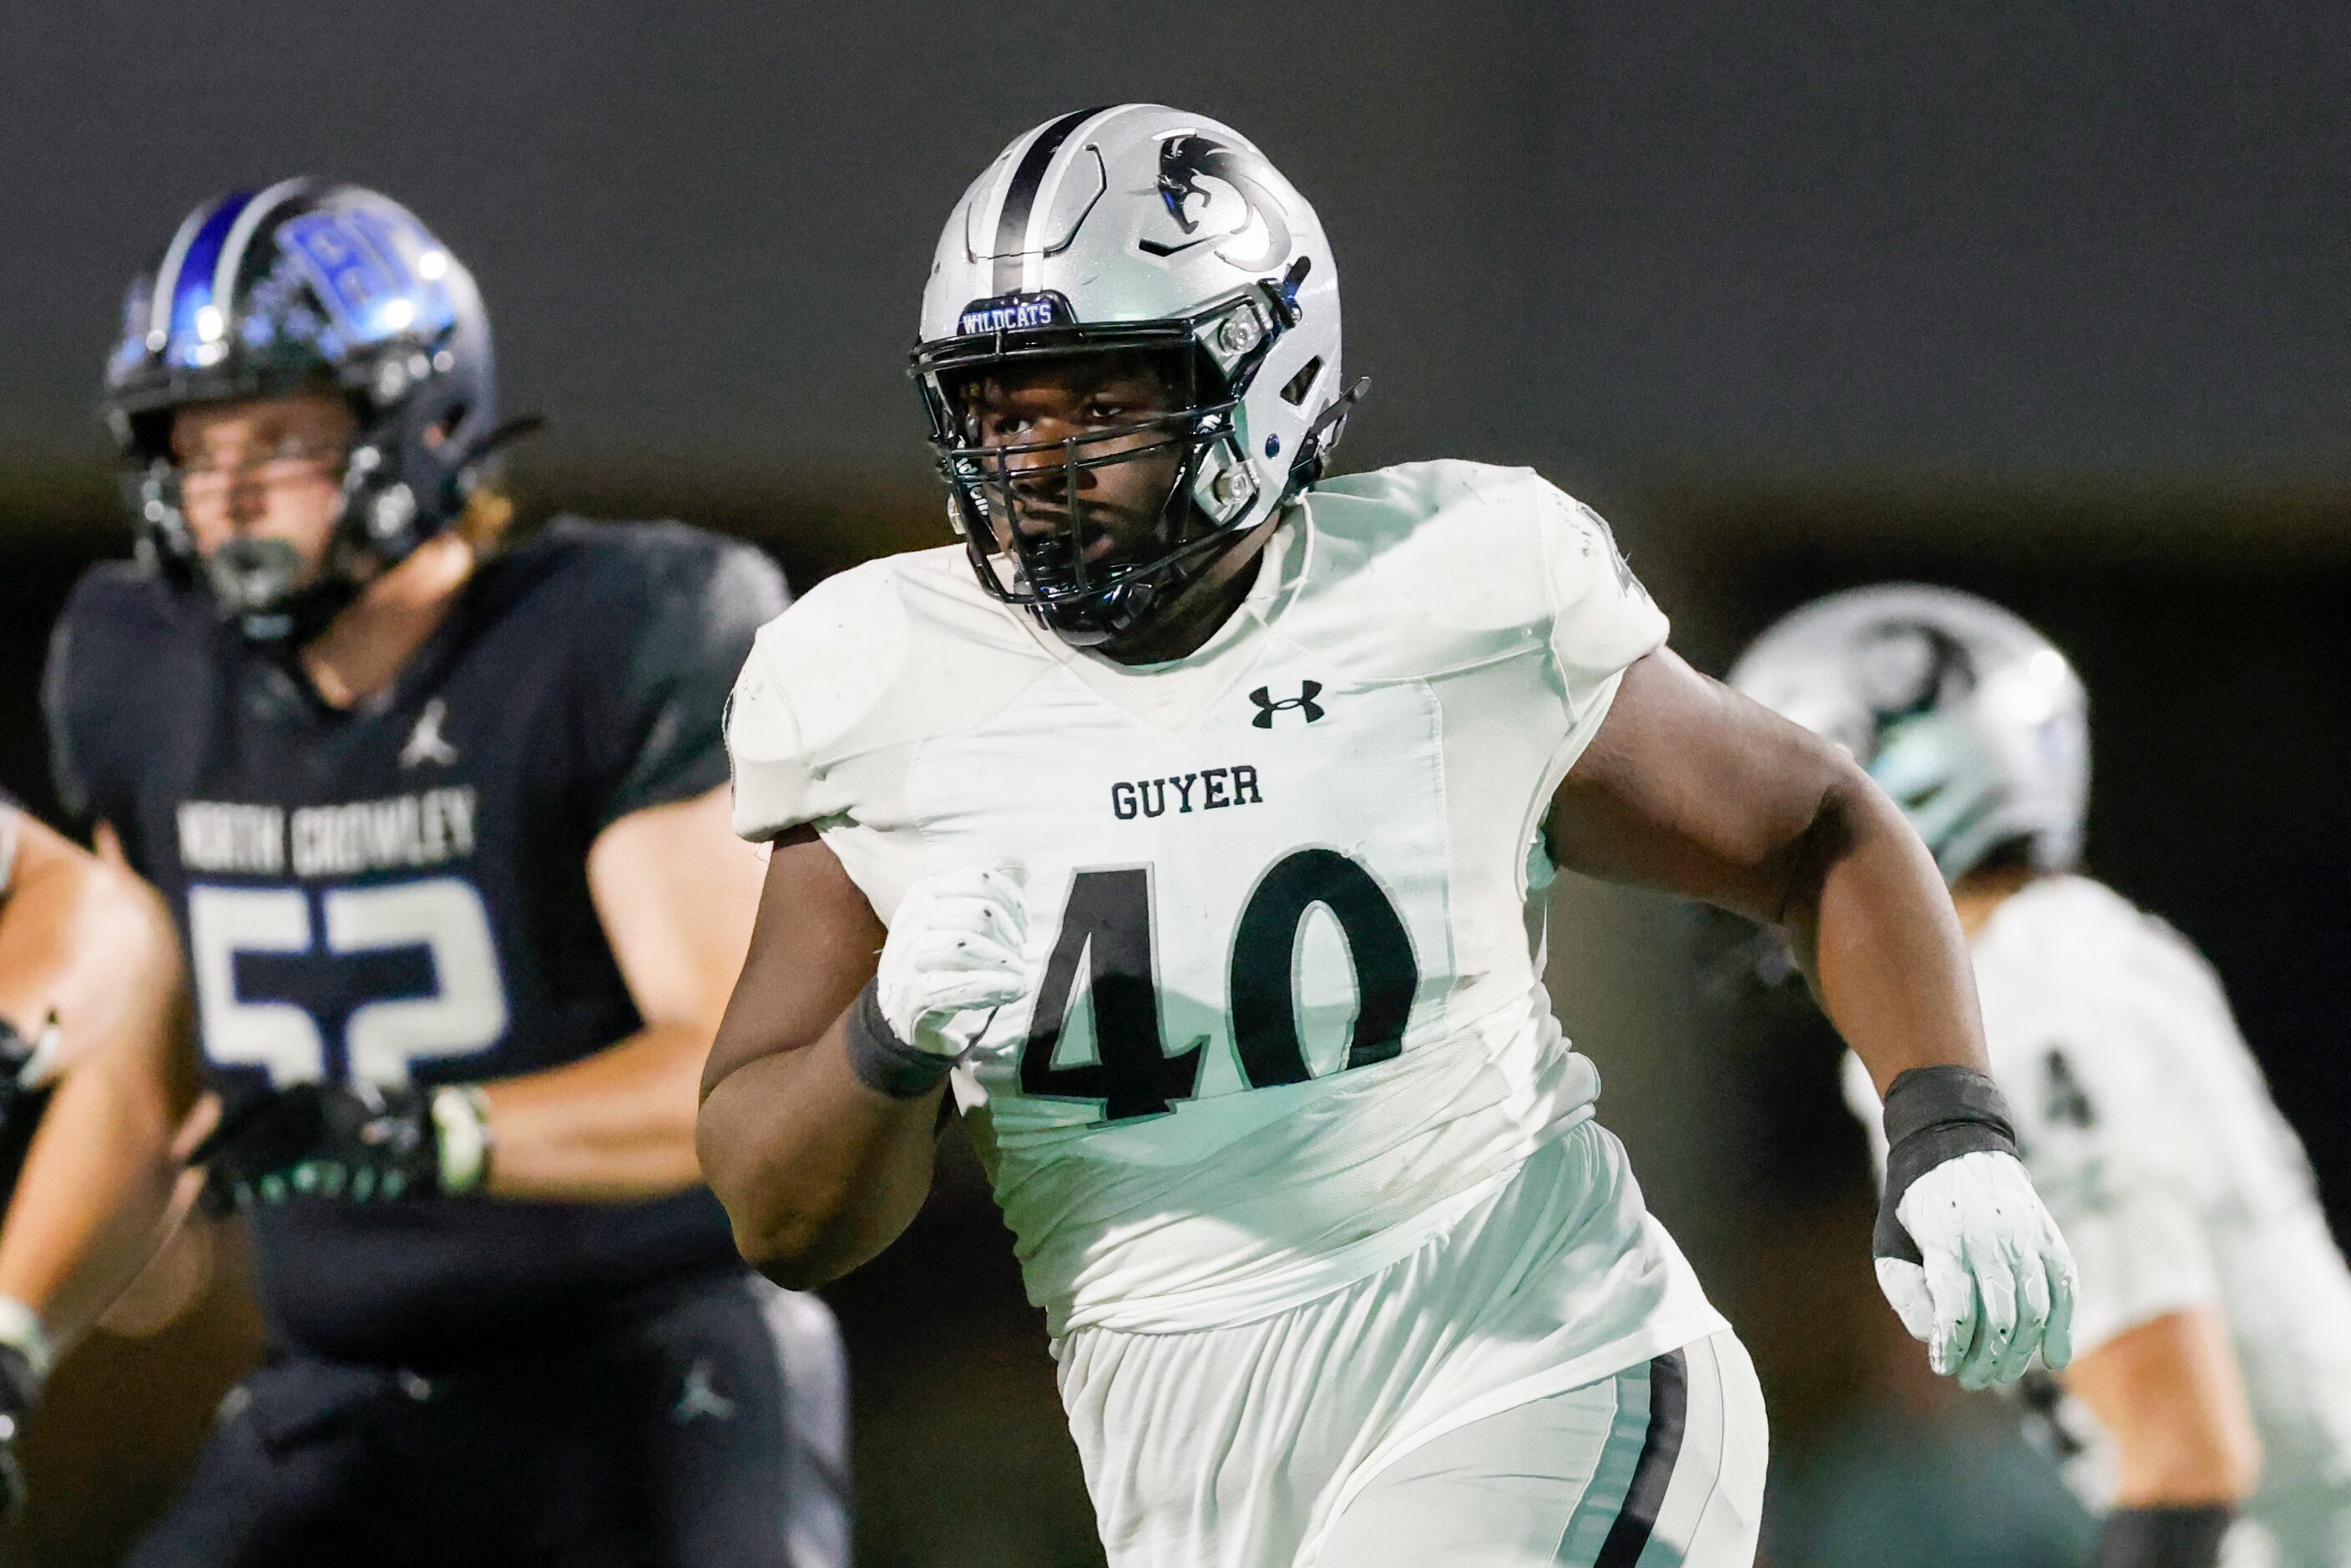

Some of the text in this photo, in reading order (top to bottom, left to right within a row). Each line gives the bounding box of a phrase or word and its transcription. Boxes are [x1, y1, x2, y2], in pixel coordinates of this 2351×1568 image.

[963, 303, 1052, 335] WILDCATS
[291, 784, 478, 878] CROWLEY
[1111, 765, 1263, 820] GUYER
[188, 875, 509, 1090] 52
[1014, 841, 1423, 1128] 40
